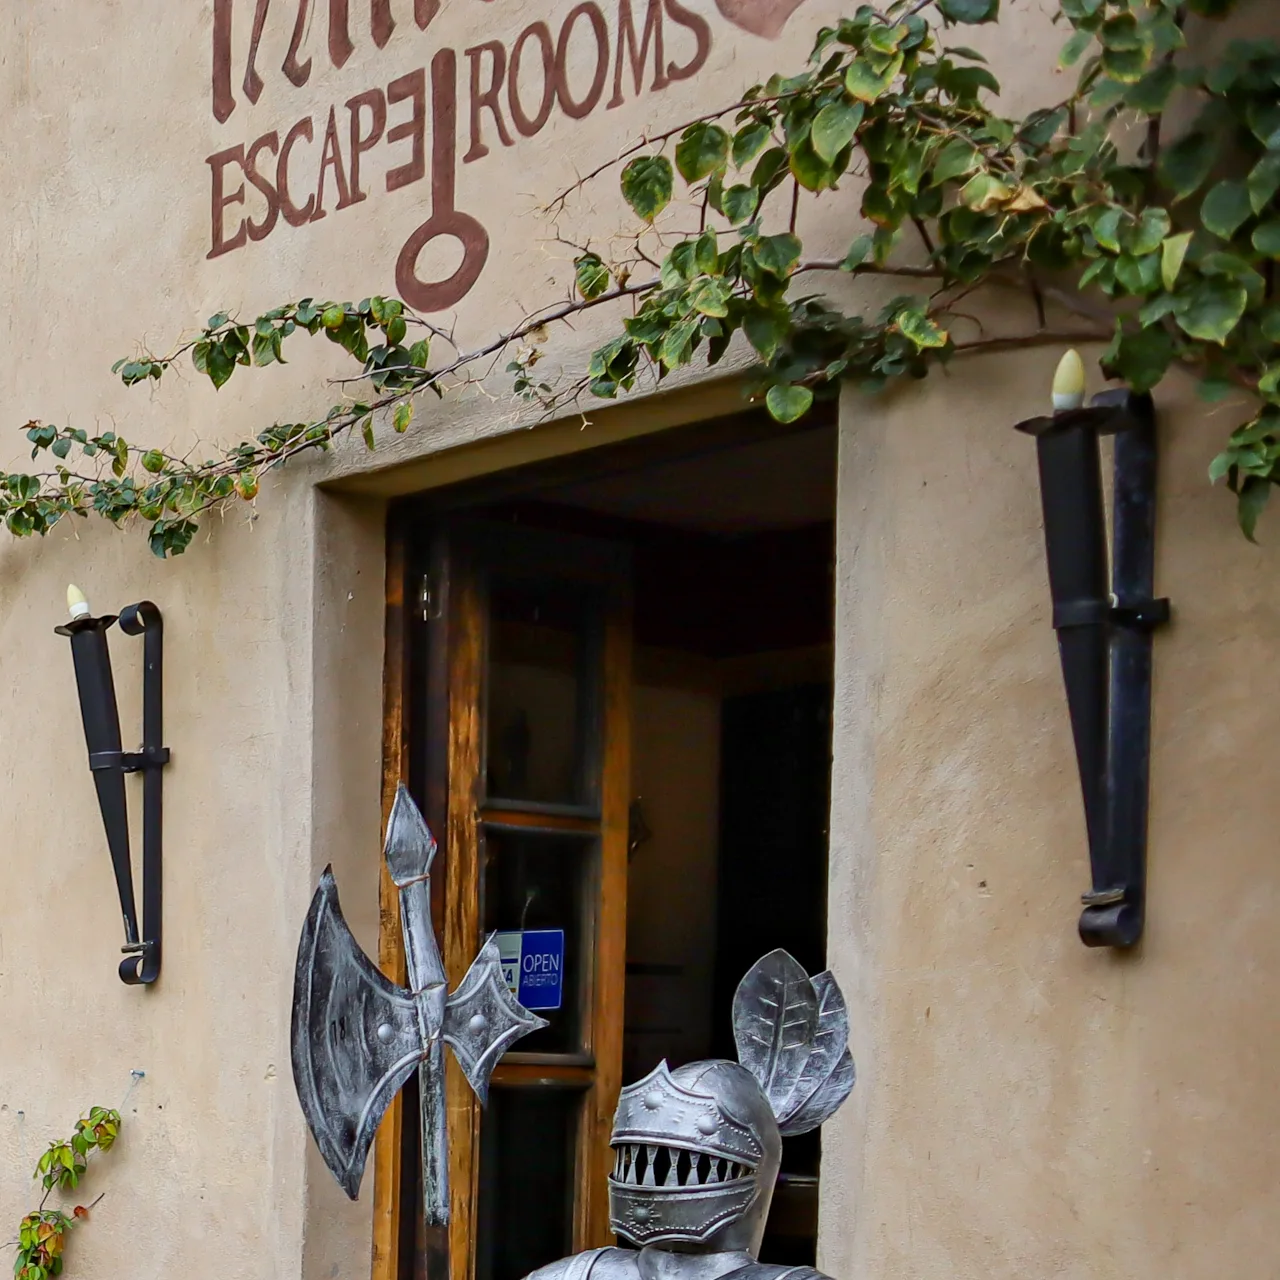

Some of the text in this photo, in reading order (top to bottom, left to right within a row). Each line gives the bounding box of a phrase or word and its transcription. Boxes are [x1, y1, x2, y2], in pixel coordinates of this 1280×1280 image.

[463, 0, 712, 164] ROOMS
[523, 953, 559, 973] OPEN
[522, 972, 558, 987] ABIERTO
